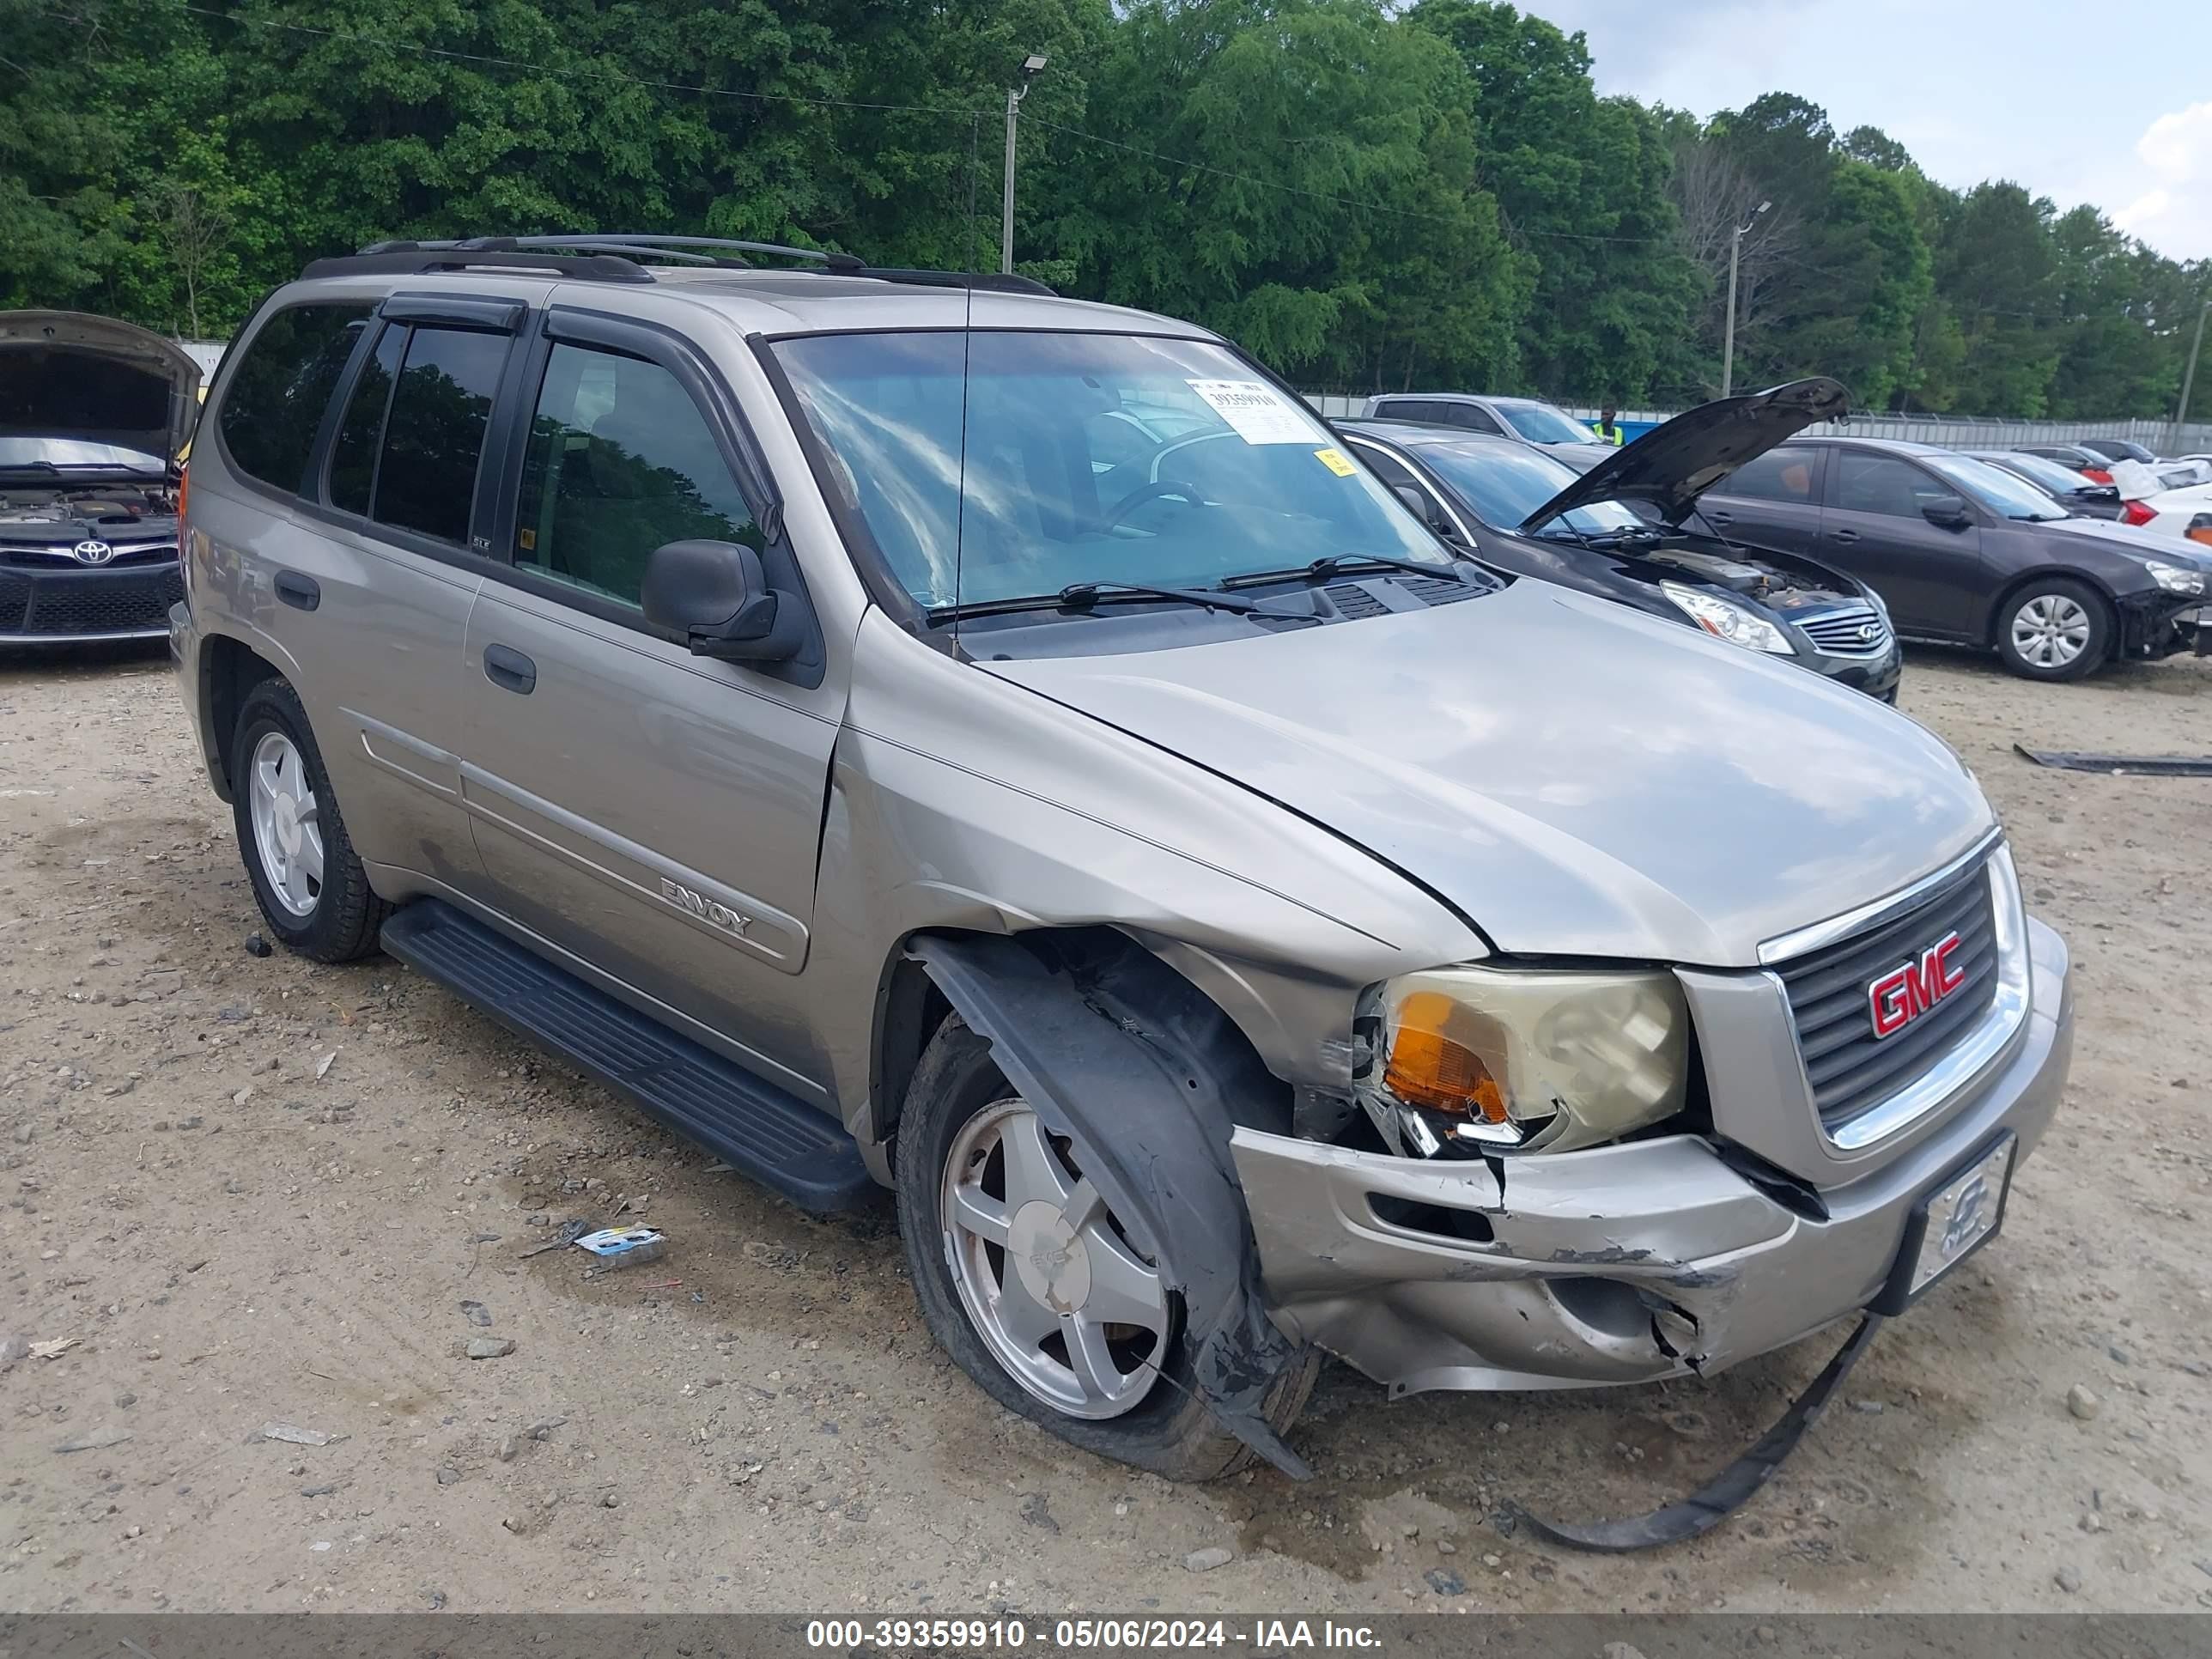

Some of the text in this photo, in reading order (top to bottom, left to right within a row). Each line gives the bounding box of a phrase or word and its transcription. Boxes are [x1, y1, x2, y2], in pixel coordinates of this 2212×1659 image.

[1209, 393, 1277, 406] 39359910
[473, 537, 490, 550] SLE
[660, 877, 752, 935] ENVOY
[1869, 931, 1965, 1039] GMC
